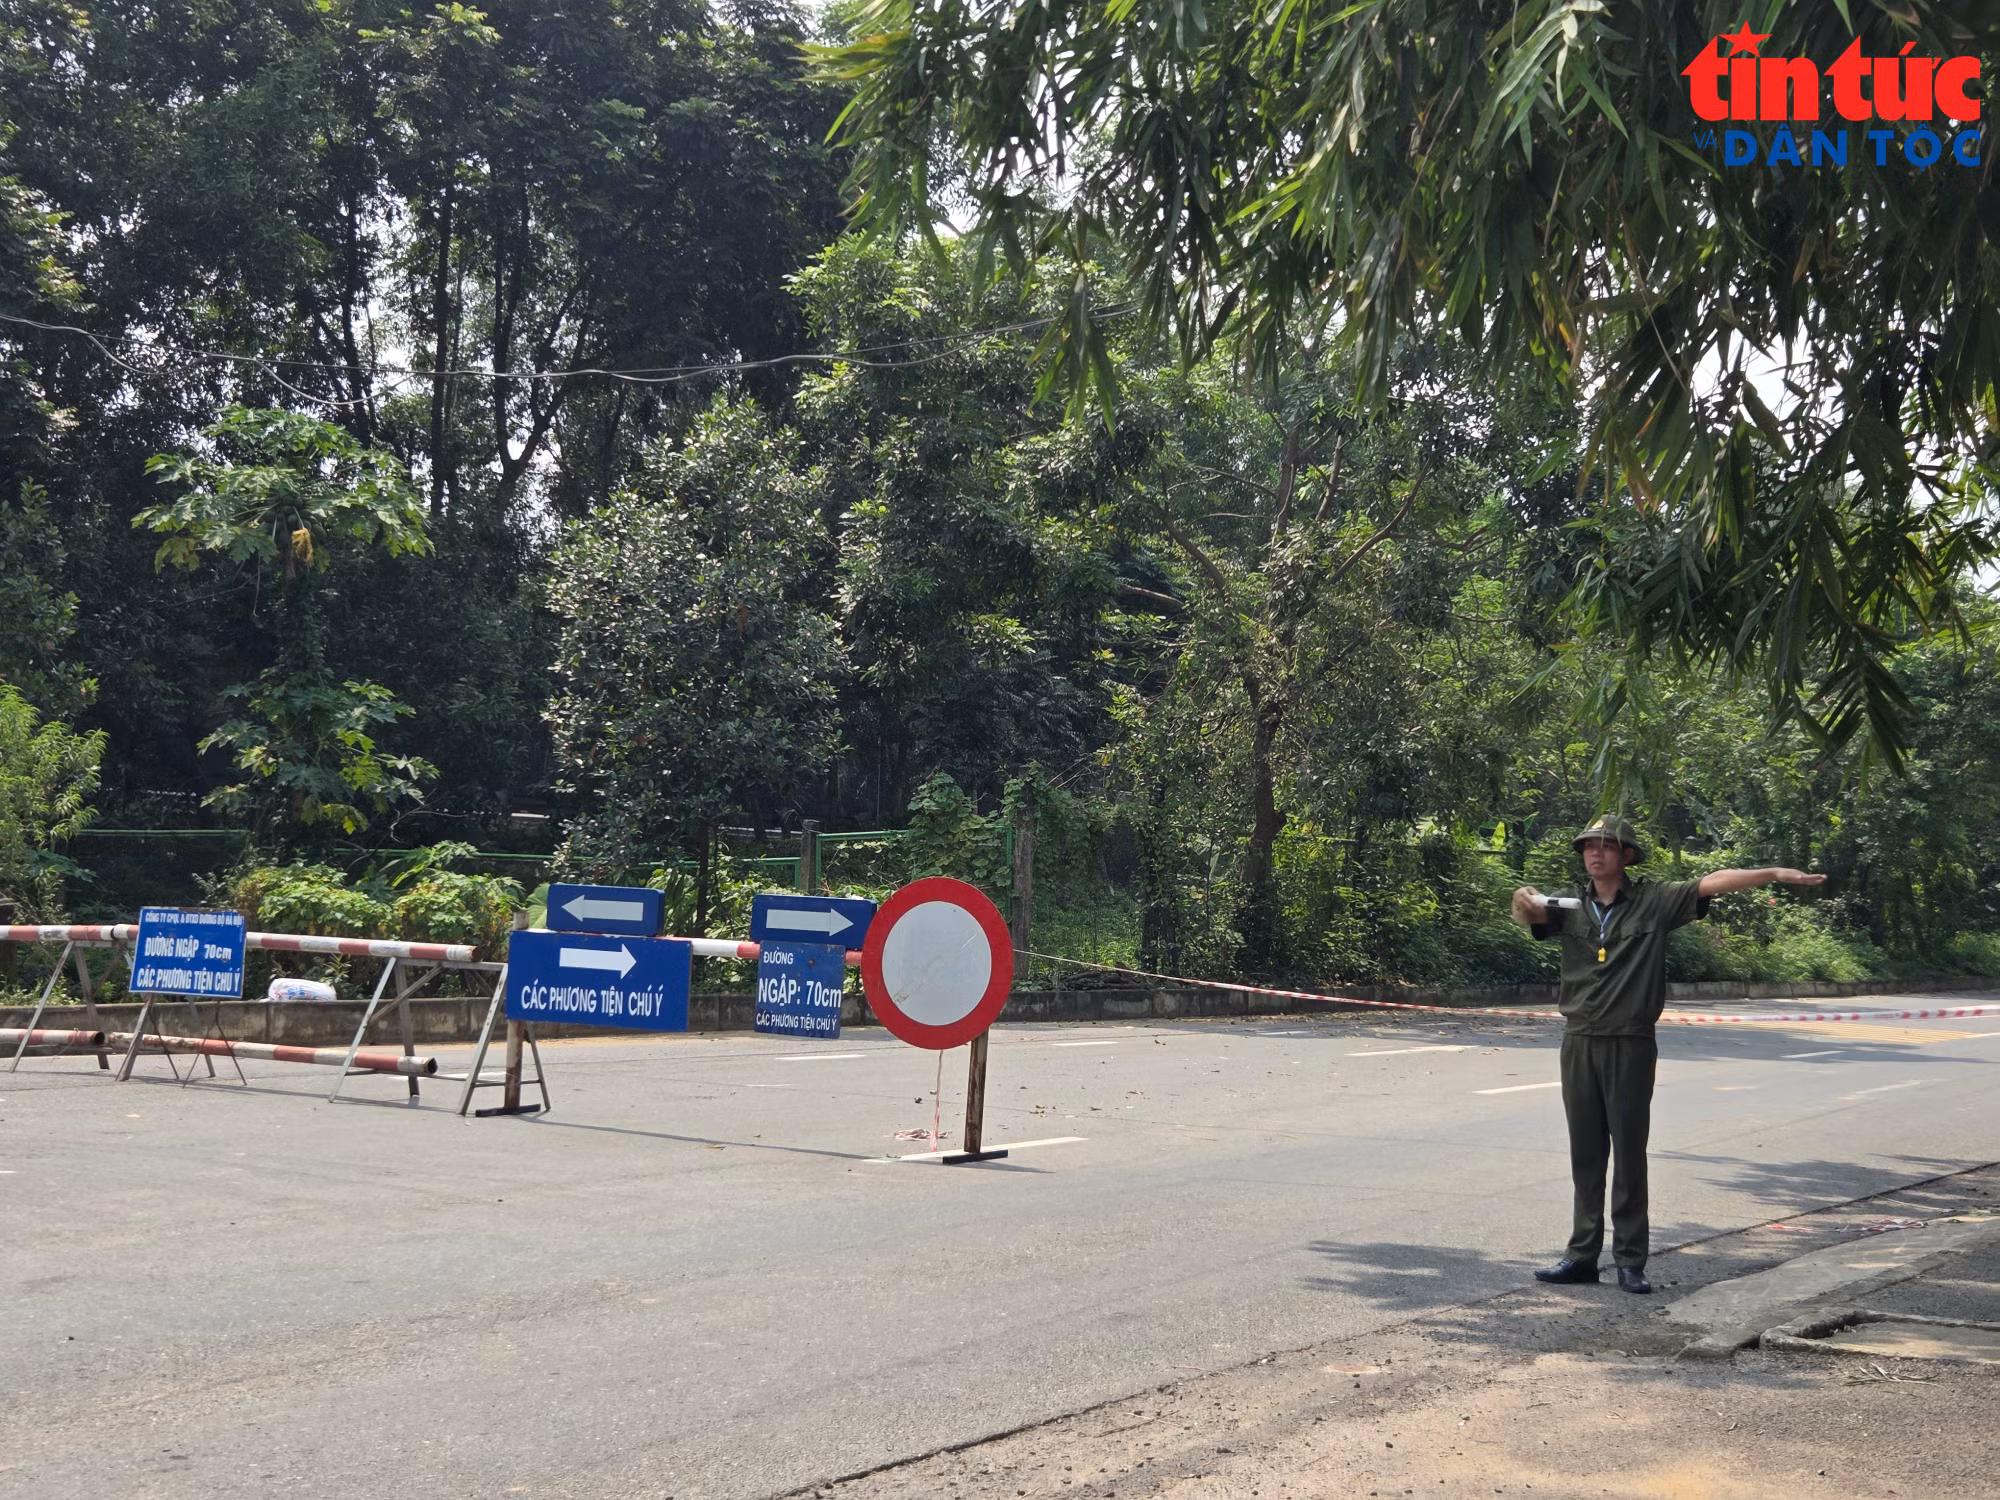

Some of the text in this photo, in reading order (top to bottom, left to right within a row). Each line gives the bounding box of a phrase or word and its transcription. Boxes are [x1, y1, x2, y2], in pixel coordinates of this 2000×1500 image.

[175, 935, 199, 961] NGẬP
[204, 944, 232, 960] 70cm
[763, 947, 793, 964] ĐƯỜNG
[137, 964, 155, 987] CÁC
[193, 967, 214, 994] TIỆN
[214, 967, 233, 992] CHÚ
[521, 978, 664, 1017] CÁC PHƯƠNG TIỆN CHÚ Ý
[806, 981, 841, 1008] 70cm
[756, 1010, 770, 1026] CÁC
[800, 1013, 815, 1031] TIỆN
[816, 1013, 831, 1030] CHÚ
